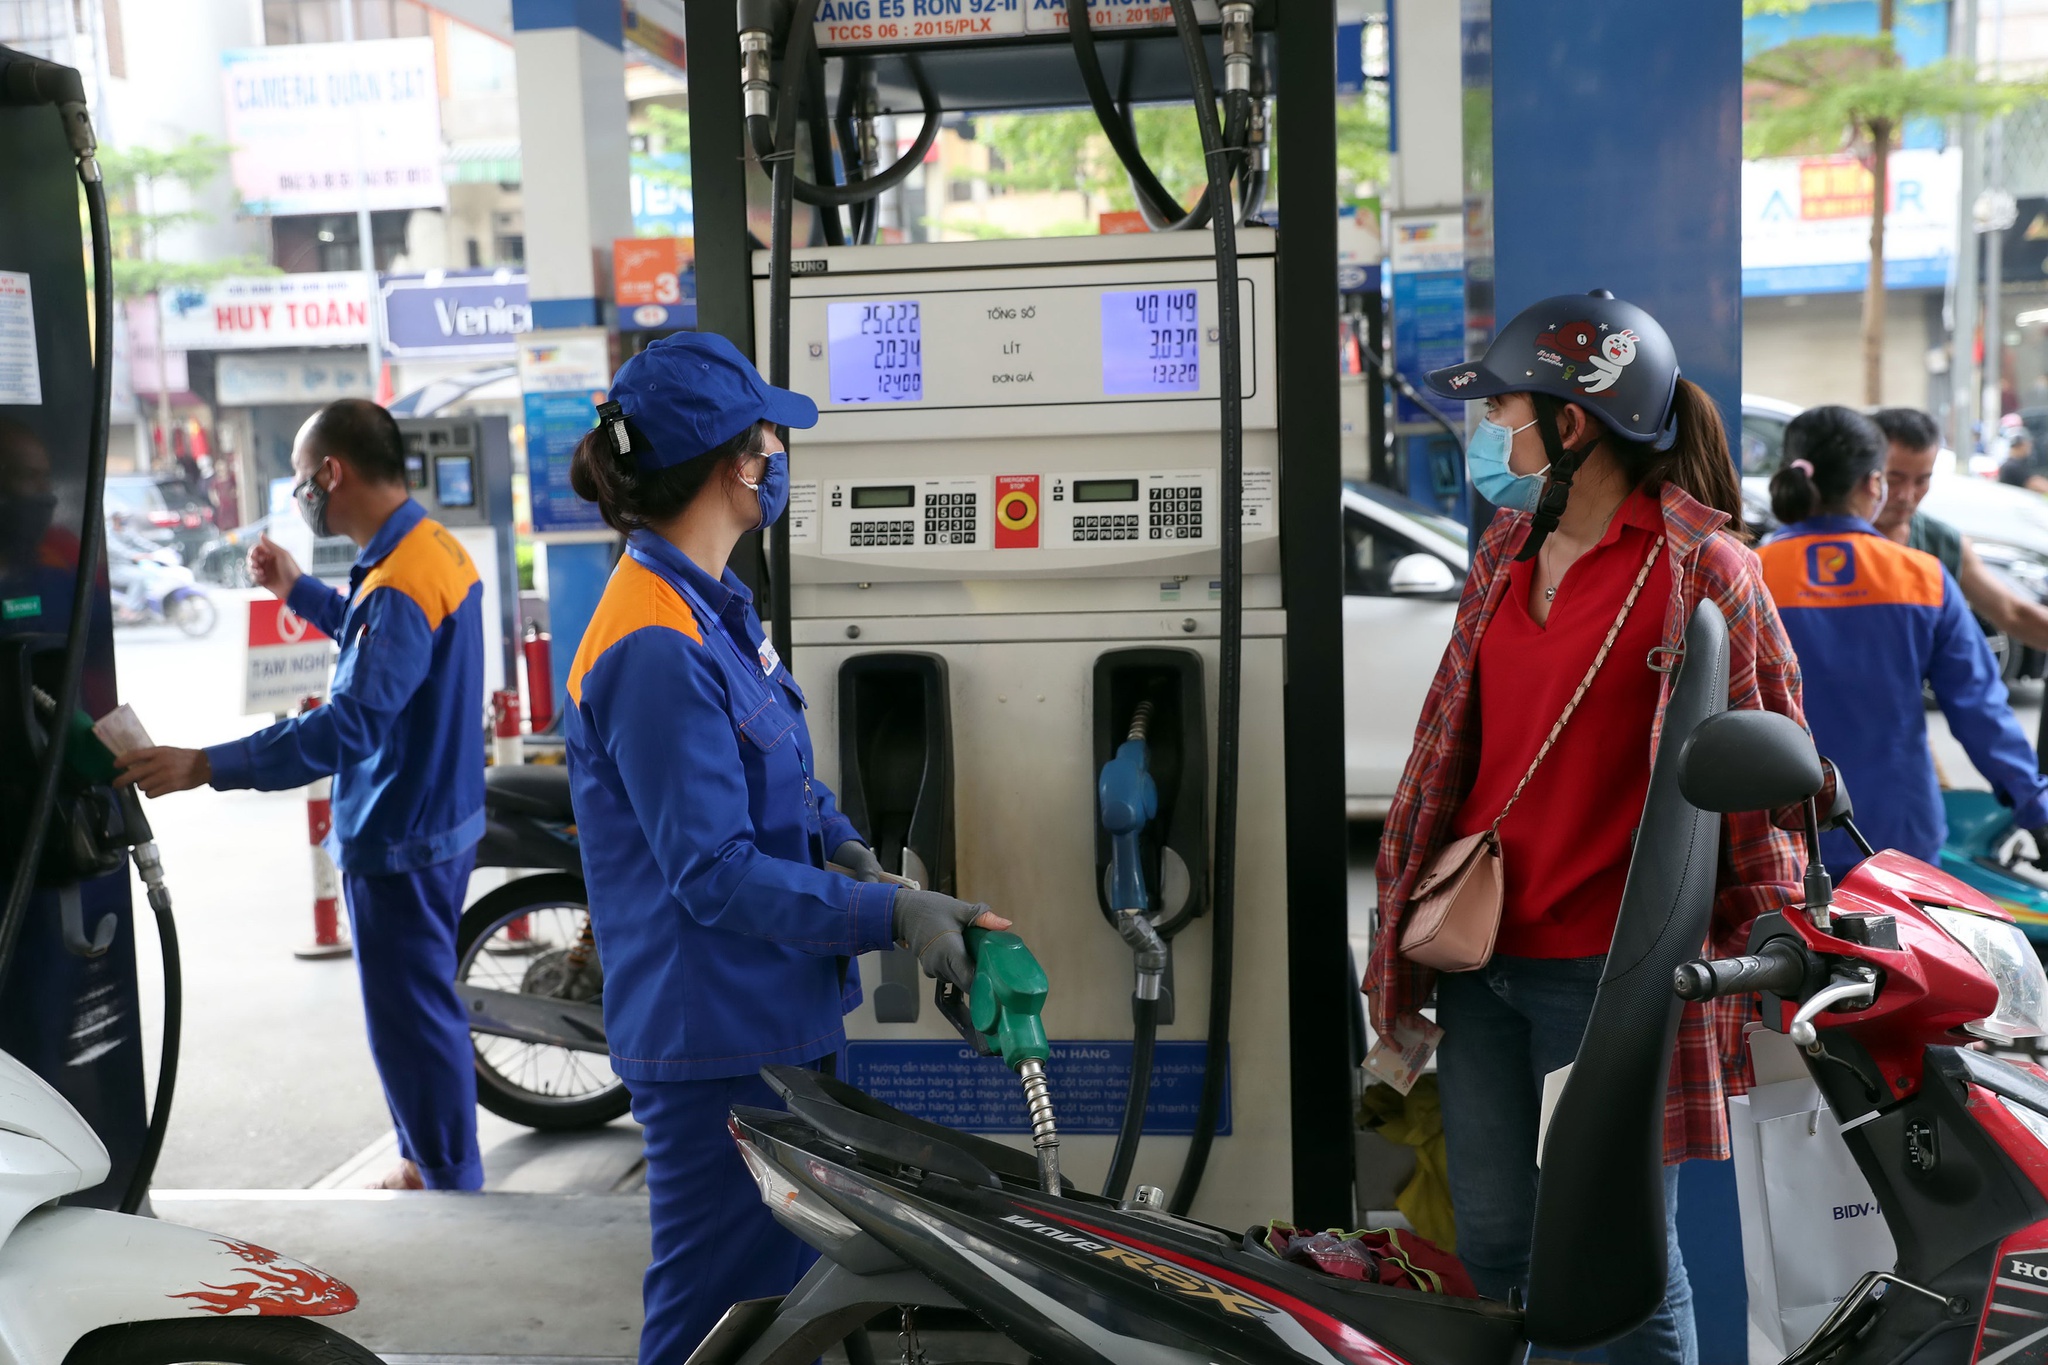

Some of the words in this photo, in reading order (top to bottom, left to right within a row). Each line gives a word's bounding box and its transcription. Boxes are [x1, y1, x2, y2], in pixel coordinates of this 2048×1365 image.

[880, 0, 905, 18] E5
[914, 0, 961, 16] RON
[1096, 10, 1111, 24] 01
[1126, 6, 1173, 23] 2015/P
[828, 24, 873, 40] TCCS
[878, 23, 898, 38] 06
[914, 17, 991, 36] 2015/PLX
[791, 262, 825, 272] SUNO
[655, 272, 680, 304] 3
[1136, 293, 1197, 323] 40149
[216, 303, 272, 331] HUY
[434, 296, 533, 337] Venic
[861, 304, 920, 335] 25222
[1003, 342, 1021, 355] LÍT
[1016, 372, 1034, 383] GIÁ
[1153, 363, 1197, 384] 13220
[878, 373, 920, 393] 12400
[1000, 476, 1036, 484] EMERGENCY
[1152, 489, 1159, 498] 7
[1165, 489, 1172, 498] 8
[1178, 488, 1186, 498] 9
[1191, 489, 1200, 497] F1
[928, 495, 935, 504] 7
[941, 495, 948, 504] 8
[953, 494, 961, 504] 9
[1152, 502, 1159, 512] 4
[1165, 502, 1172, 511] 5
[1178, 501, 1186, 511] 6
[927, 508, 934, 517] 4
[940, 508, 948, 517] 5
[953, 508, 960, 517] 6
[927, 521, 933, 531] 1
[940, 521, 947, 530] 2
[953, 520, 960, 530] 3
[1074, 518, 1083, 526] P1
[1087, 518, 1097, 526] P2
[1101, 517, 1110, 525] P3
[1114, 517, 1124, 525] P4
[1152, 516, 1158, 525] 1
[1165, 515, 1172, 525] 2
[1178, 515, 1186, 524] 3
[851, 524, 861, 532] P1
[865, 524, 874, 532] P2
[877, 523, 887, 531] P3
[890, 523, 900, 531] P4
[1152, 529, 1159, 538] 0
[1165, 528, 1173, 538] C
[864, 536, 874, 544] P7
[927, 534, 934, 544] 0
[940, 534, 948, 543] C
[1088, 531, 1097, 539] P7
[958, 1049, 979, 1059] QU
[1095, 1245, 1274, 1318] RSX
